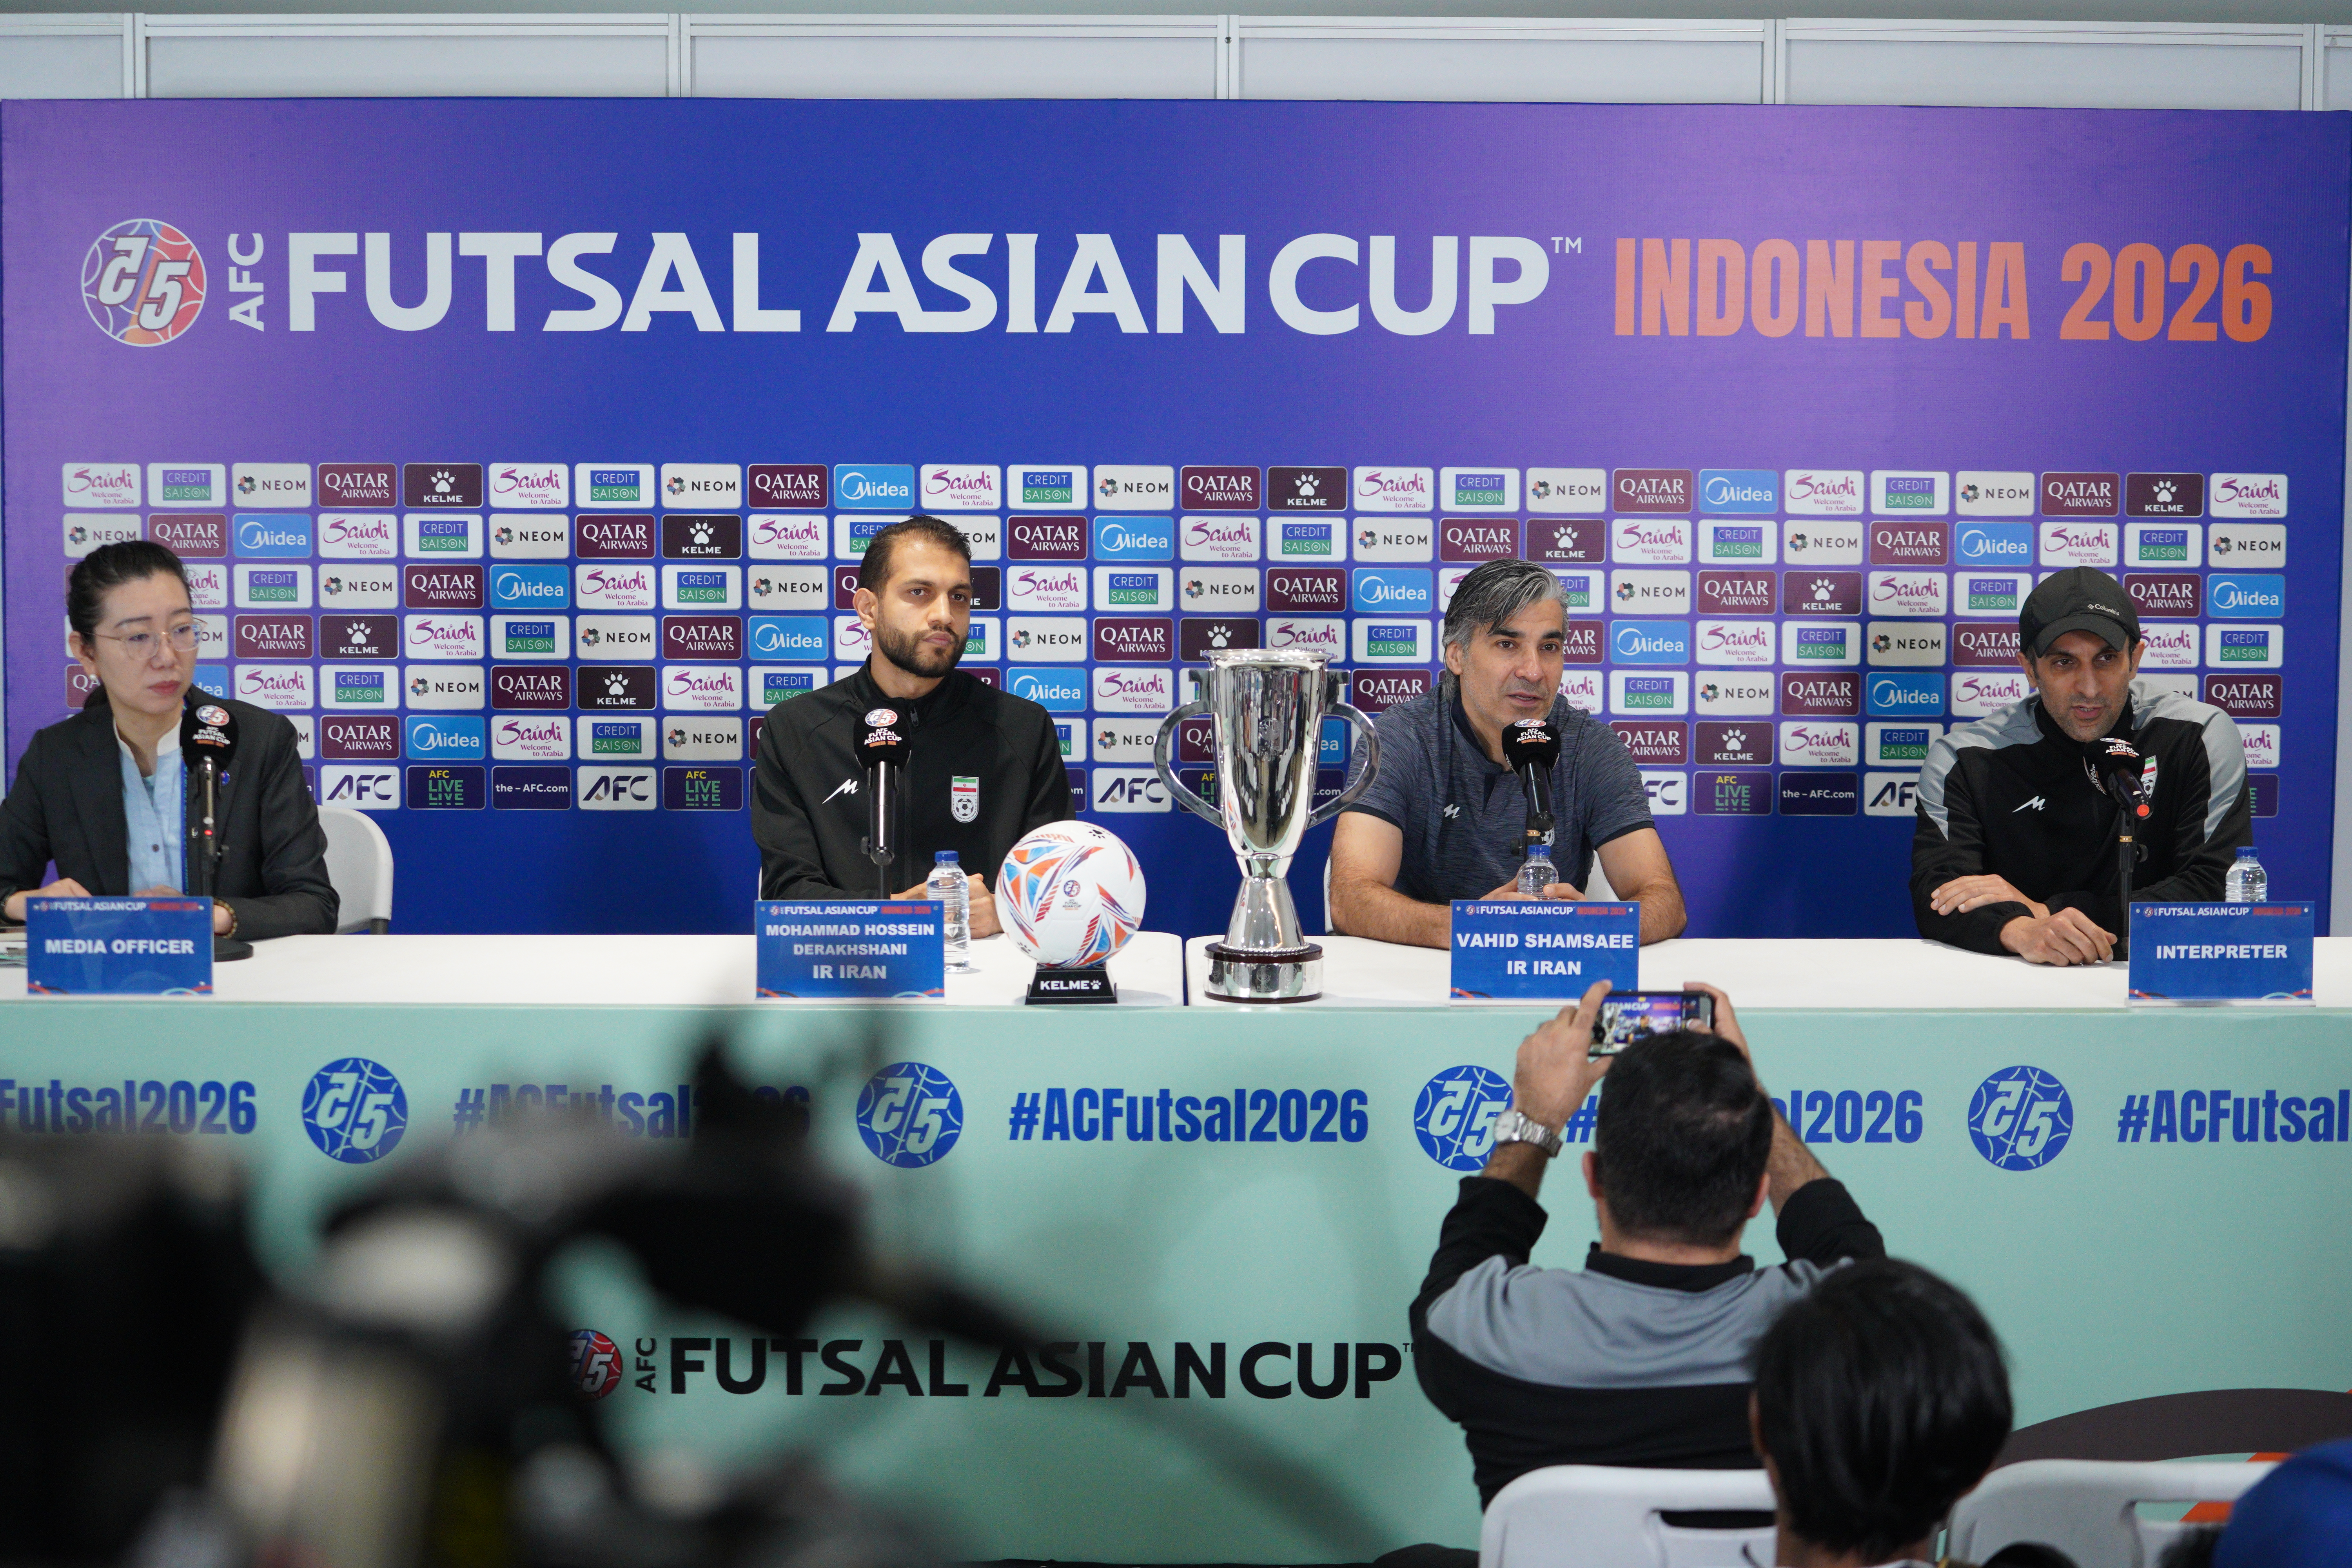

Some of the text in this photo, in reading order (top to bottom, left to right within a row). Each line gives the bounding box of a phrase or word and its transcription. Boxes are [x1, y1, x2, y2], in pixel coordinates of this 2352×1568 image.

[229, 232, 264, 332] AFC
[289, 232, 801, 332] FUTSAL
[826, 232, 1246, 333] ASIAN
[1269, 234, 1550, 336] CUP
[1615, 238, 2030, 339] INDONESIA
[2059, 242, 2272, 342] 2026
[68, 467, 133, 492] Saudi
[167, 473, 207, 483] CREDIT
[595, 474, 635, 484] CREDIT
[755, 474, 820, 492] QATAR
[1359, 470, 1425, 496] Saudi
[262, 480, 306, 490] NEOM
[692, 481, 736, 491] NEOM
[842, 481, 908, 500] Midea
[1557, 485, 1601, 495] NEOM
[1620, 479, 1684, 496] QATAR
[1790, 474, 1856, 499] Saudi
[1890, 481, 1930, 491] CREDIT
[2215, 477, 2279, 503] Saudi
[165, 488, 209, 498] SAISON
[593, 488, 638, 499] SAISON
[771, 490, 820, 500] AIRWAYS
[1986, 489, 2029, 499] NEOM
[2048, 482, 2112, 500] QATAR
[1637, 495, 1684, 504] AIRWAYS
[1889, 495, 1933, 506] SAISON
[2064, 498, 2112, 508] AIRWAYS
[155, 524, 219, 541] QATAR
[423, 524, 463, 534] CREDIT
[583, 524, 647, 542] QATAR
[240, 531, 306, 549] Midea
[520, 531, 564, 541] NEOM
[1384, 535, 1428, 545] NEOM
[1718, 530, 1757, 540] CREDIT
[172, 540, 220, 549] AIRWAYS
[421, 539, 466, 549] SAISON
[599, 540, 648, 550] AIRWAYS
[1101, 533, 1168, 552] Midea
[2238, 541, 2281, 551] NEOM
[1716, 544, 1760, 555] SAISON
[1114, 576, 1154, 586] CREDIT
[1274, 577, 1338, 595] QATAR
[779, 583, 822, 593] NEOM
[1642, 587, 1685, 597] NEOM
[1112, 592, 1156, 601] SAISON
[1290, 593, 1339, 603] AIRWAYS
[2214, 591, 2279, 609] Midea
[2094, 604, 2120, 615] Columbia
[241, 624, 305, 642] QATAR
[1372, 628, 1412, 639] CREDIT
[2225, 634, 2264, 644] CREDIT
[258, 641, 306, 650] AIRWAYS
[1370, 643, 1414, 653] SAISON
[1618, 637, 1684, 655] Midea
[2223, 648, 2267, 658] SAISON
[1726, 688, 1769, 698] NEOM
[1788, 682, 1852, 699] QATAR
[2211, 684, 2274, 701] QATAR
[1804, 698, 1852, 707] AIRWAYS
[2227, 700, 2274, 709] AIRWAYS
[864, 736, 886, 745] ASIAN
[326, 775, 392, 800] AFC
[429, 780, 464, 792] LIVE
[583, 776, 648, 801] AFC
[686, 781, 720, 793] LIVE
[1098, 778, 1164, 803] AFC
[1716, 786, 1751, 798] LIVE
[54, 902, 92, 911] FUTSAL
[94, 902, 125, 911] ASIAN
[125, 902, 147, 911] CUP
[784, 906, 823, 915] FUTSAL
[824, 906, 855, 915] ASIAN
[856, 906, 878, 915] CUP
[1480, 906, 1519, 915] FUTSAL
[1520, 906, 1551, 915] ASIAN
[1552, 906, 1573, 915] CUP
[2158, 907, 2196, 916] FUTSAL
[2197, 907, 2228, 916] ASIAN
[2229, 907, 2249, 916] CUP
[766, 924, 935, 936] MOHAMMAD HOSSEIN
[45, 939, 195, 954] MEDIA OFFICER
[1456, 933, 1634, 949] VAHID SHAMSAEE
[793, 944, 907, 956] DERAKHSHANI
[2156, 944, 2288, 959] INTERPRETER
[813, 965, 887, 979] IR IRAN
[1507, 960, 1581, 975] IR IRAN
[1040, 980, 1090, 990] KELME
[1009, 1087, 1369, 1143] #ACFutsal2026
[2117, 1089, 2351, 1143] #ACFutsal
[635, 1338, 657, 1394] AFC
[670, 1337, 969, 1397] FUTSAL
[983, 1341, 1227, 1399] ASIAN
[1239, 1341, 1402, 1399] CUP
